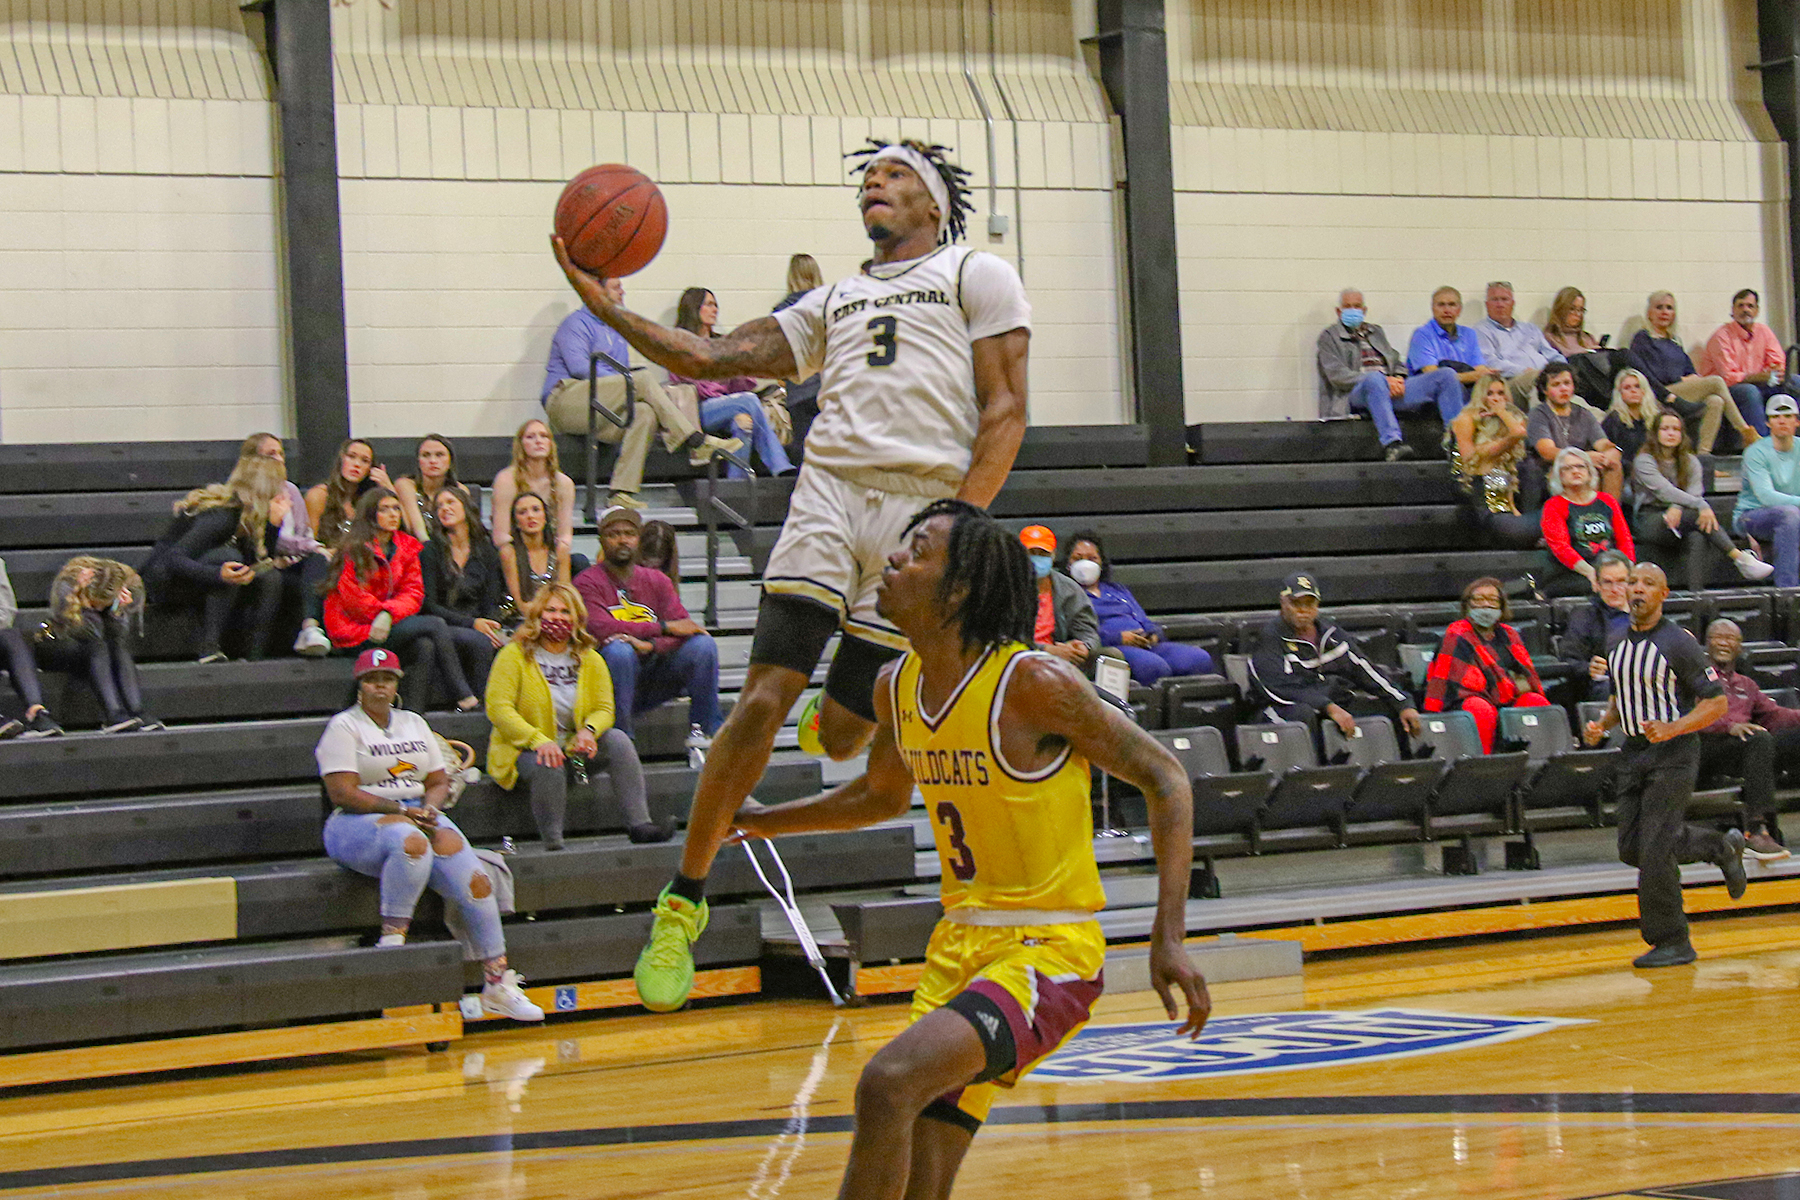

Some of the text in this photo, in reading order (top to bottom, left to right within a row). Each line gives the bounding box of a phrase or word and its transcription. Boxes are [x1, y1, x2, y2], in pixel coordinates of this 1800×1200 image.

[833, 290, 950, 322] EAST CENTRAL
[867, 316, 897, 367] 3
[1584, 521, 1606, 535] JOY
[368, 739, 429, 757] WILDCATS
[936, 801, 978, 881] 3
